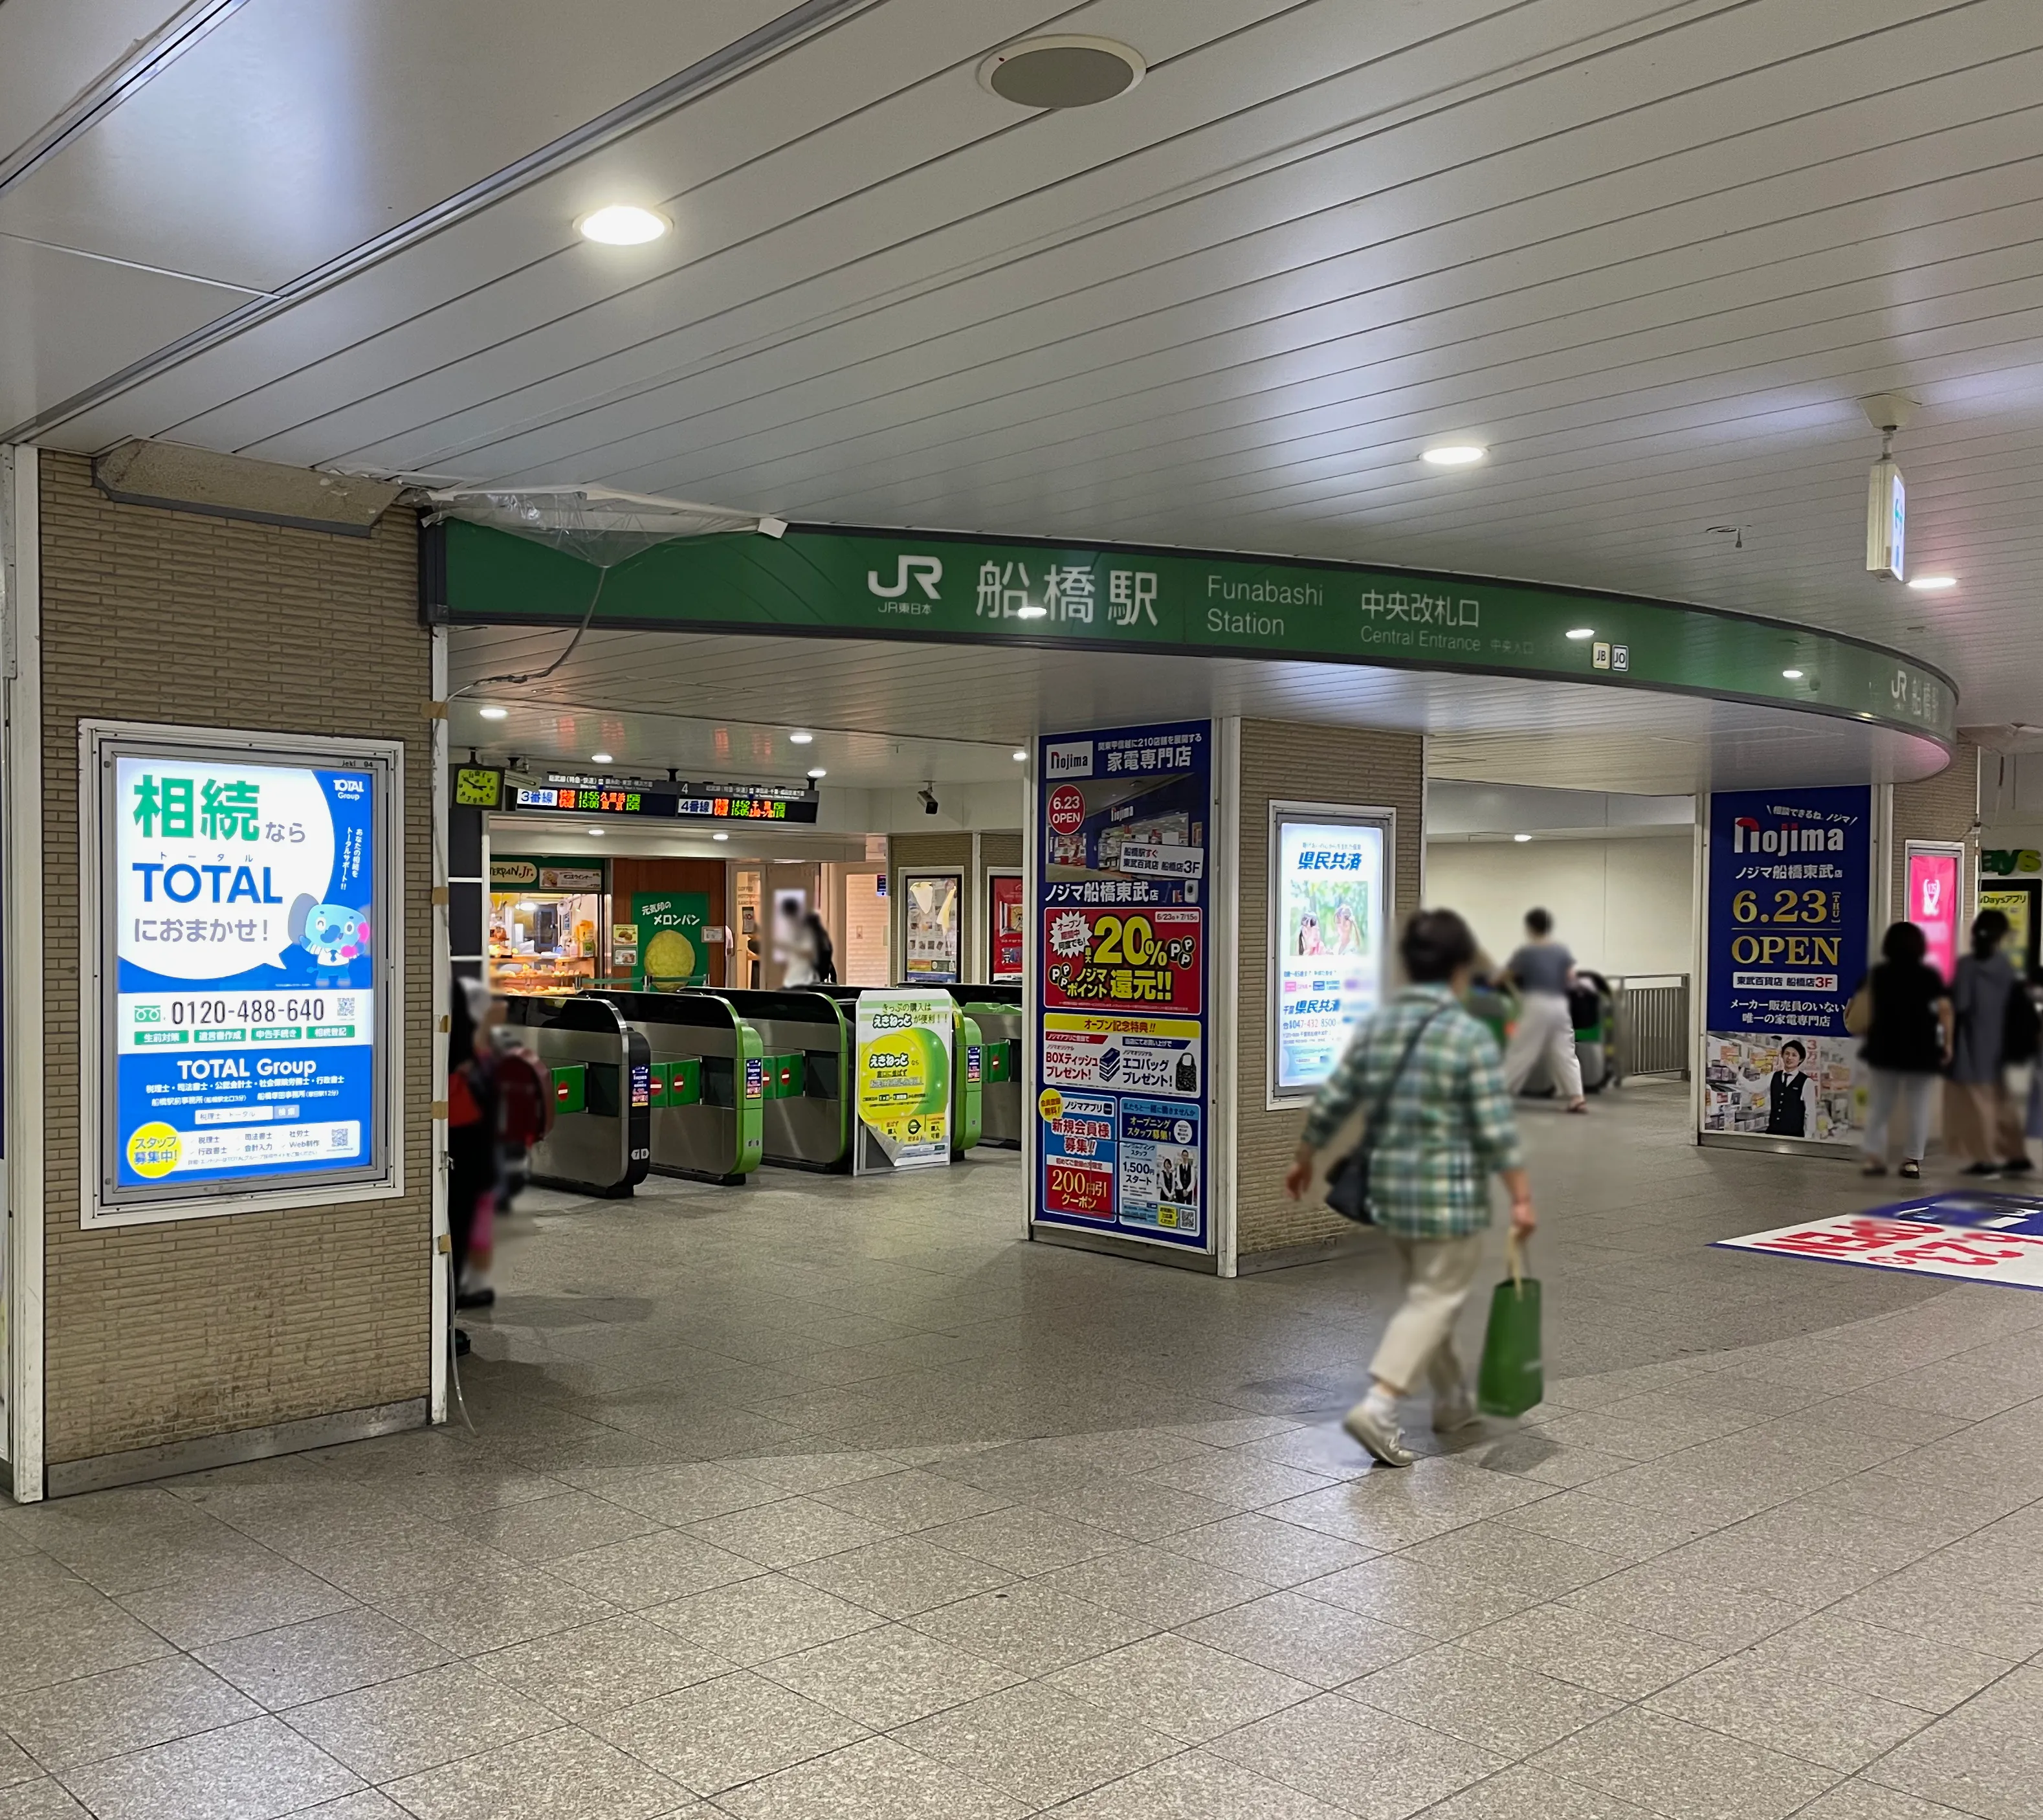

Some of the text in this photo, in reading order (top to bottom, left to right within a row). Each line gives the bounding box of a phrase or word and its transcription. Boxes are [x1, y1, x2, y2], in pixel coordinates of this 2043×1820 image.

[868, 554, 943, 600] JR
[976, 560, 1158, 627] 船橋駅
[1207, 574, 1323, 606] Funabashi
[878, 601, 933, 616] JR東日本
[1360, 588, 1480, 628] 中央改札口
[1207, 610, 1285, 636] Station
[1360, 625, 1481, 652] Central Entrance
[1596, 650, 1606, 661] JB
[1614, 652, 1626, 664] JO
[1891, 669, 1907, 702] JR
[1107, 746, 1192, 772] 家電専門店
[333, 779, 364, 792] TOTAL
[681, 783, 689, 794] 4
[337, 792, 360, 801] Group
[521, 791, 553, 804] 3番線
[1053, 796, 1081, 810] 6.23
[681, 801, 709, 813] 4番線
[1052, 813, 1081, 825] OPEN
[1298, 851, 1363, 871] 県民共済
[1735, 864, 1843, 880] ノジマ船橋東武店
[132, 862, 283, 904] TOTAL
[1045, 881, 1159, 903] ノジマ船橋東武店
[1732, 890, 1827, 924] 6.23
[654, 915, 700, 926] メロンパン
[1057, 920, 1081, 931] オープン
[134, 918, 269, 943] におまかせ!
[1731, 936, 1842, 966] OPEN
[1076, 968, 1107, 982] ノジマ
[1737, 976, 1783, 986] 東武百貨店
[1067, 982, 1107, 998] ポイント
[171, 998, 324, 1025] 0120-488-640
[883, 1003, 932, 1013] きっぷの購入は
[1730, 999, 1846, 1012] メーカー販売員のいない
[872, 1013, 912, 1028] えきねっと
[1742, 1012, 1831, 1027] 唯一の家電専門店
[256, 1029, 297, 1039] 申告手続き
[315, 1027, 347, 1037] 相続登記
[869, 1052, 909, 1069] えきねっと
[1046, 1052, 1098, 1067] BOXティッシュ
[1123, 1058, 1169, 1072] エコバッグ
[177, 1058, 316, 1080] TOTAL Group
[1065, 1101, 1102, 1113] ノジマアプリ
[1052, 1118, 1110, 1138] 新規会員様
[1130, 1116, 1171, 1129] オープニング
[135, 1137, 177, 1149] スタッフ
[245, 1143, 272, 1152] 会計入力
[1052, 1170, 1107, 1198] 200円引
[1126, 1175, 1152, 1186] スタート
[1061, 1193, 1097, 1209] クーポン
